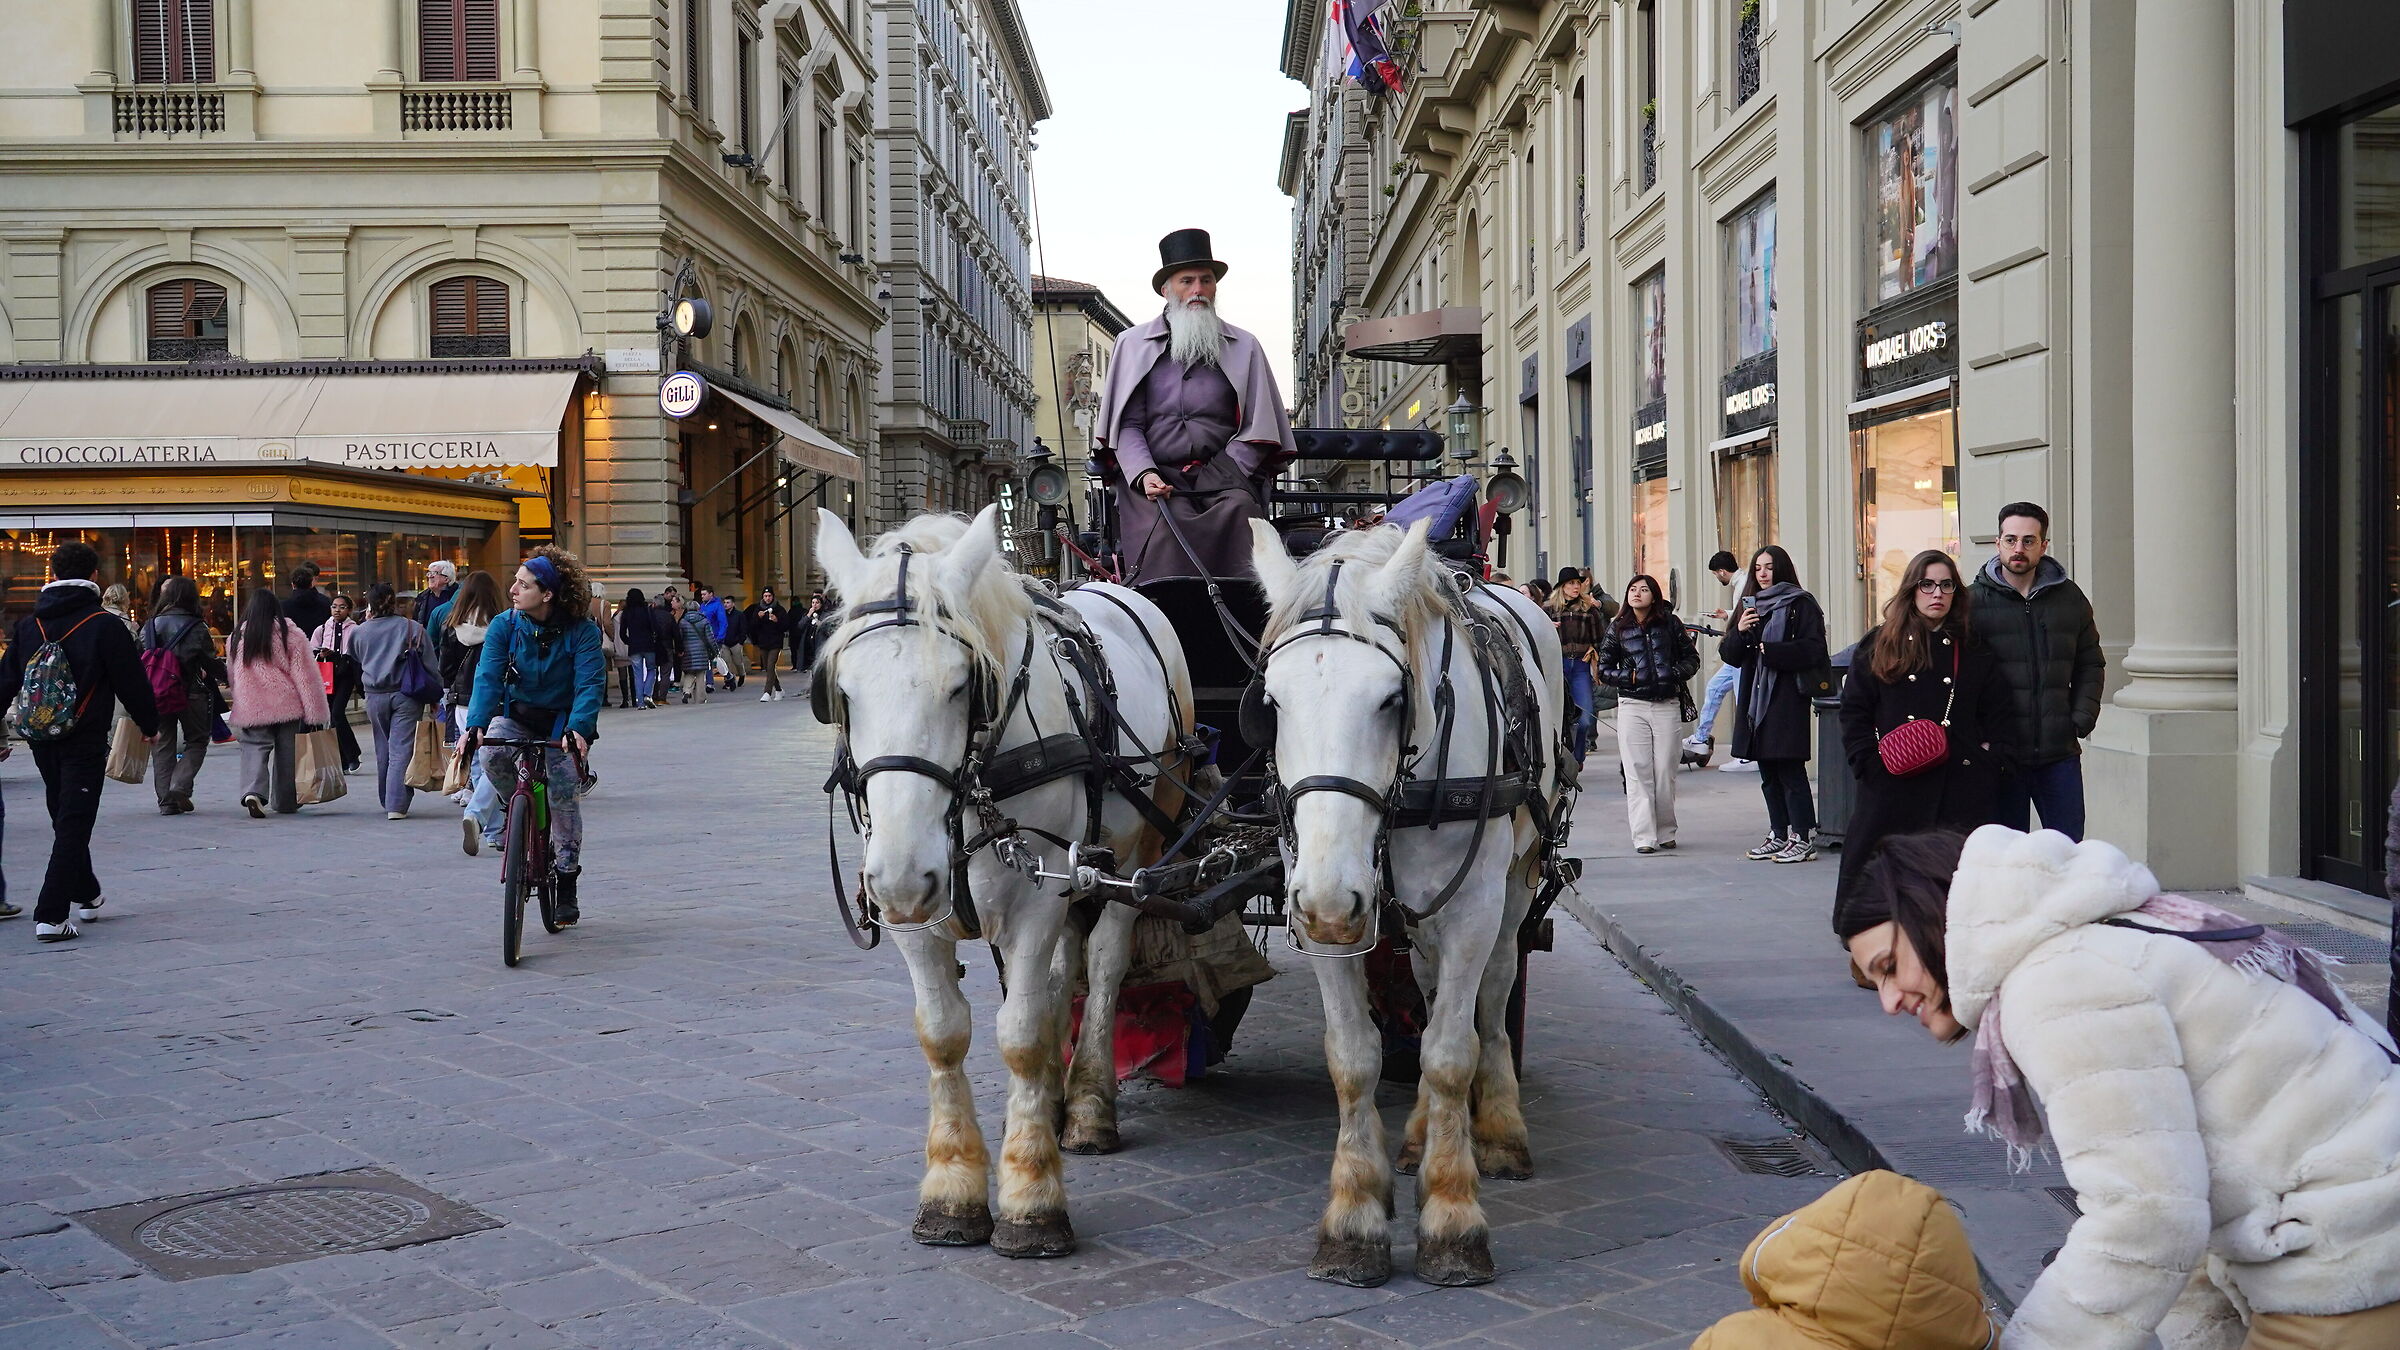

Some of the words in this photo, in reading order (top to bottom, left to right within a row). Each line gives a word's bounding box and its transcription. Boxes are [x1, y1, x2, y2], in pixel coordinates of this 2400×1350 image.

[1867, 332, 1908, 369] MICHAEL
[1909, 322, 1946, 355] KORS
[1726, 390, 1752, 415] MICHAEL
[1752, 383, 1775, 407] KORS
[20, 445, 217, 463] CIOCCOLATERIA
[345, 441, 500, 460] PASTICCERIA
